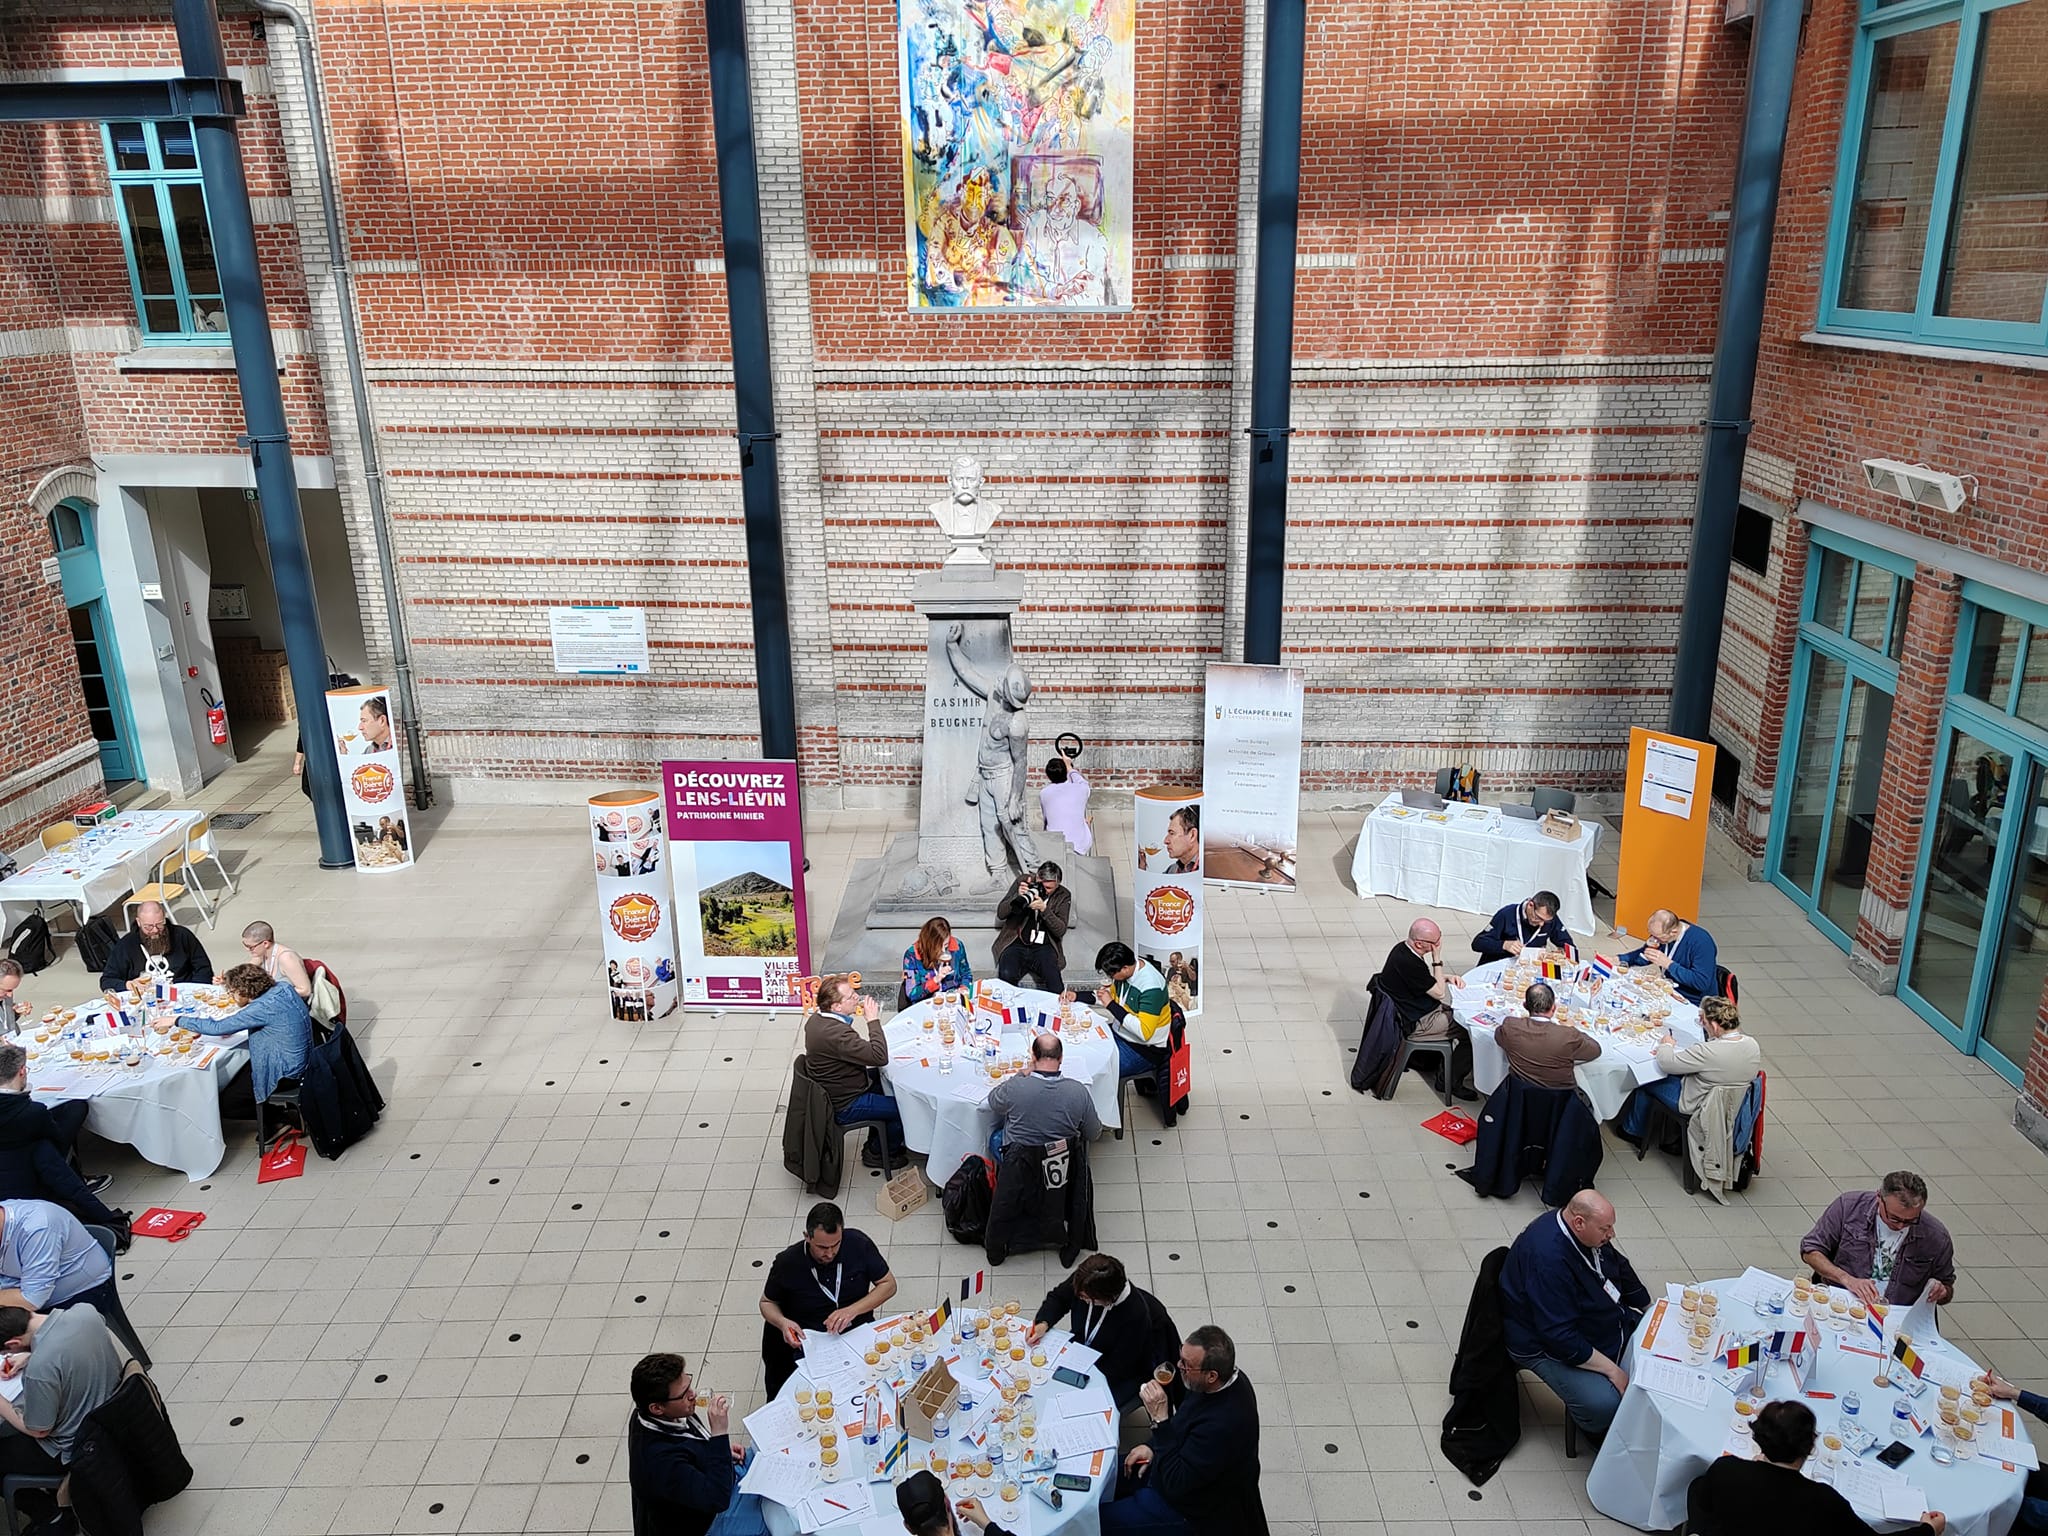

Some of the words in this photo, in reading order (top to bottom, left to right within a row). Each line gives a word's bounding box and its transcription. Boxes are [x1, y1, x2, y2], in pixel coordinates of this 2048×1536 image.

[933, 698, 981, 707] CASIMIR
[1272, 709, 1293, 718] BIÈRE
[930, 718, 983, 728] BEUGNET
[674, 770, 785, 788] DÉCOUVREZ
[675, 789, 786, 806] LENS-LIÉVIN
[676, 811, 732, 820] PATRIMOINE
[733, 812, 765, 820] MINIER
[764, 961, 800, 970] VILLES
